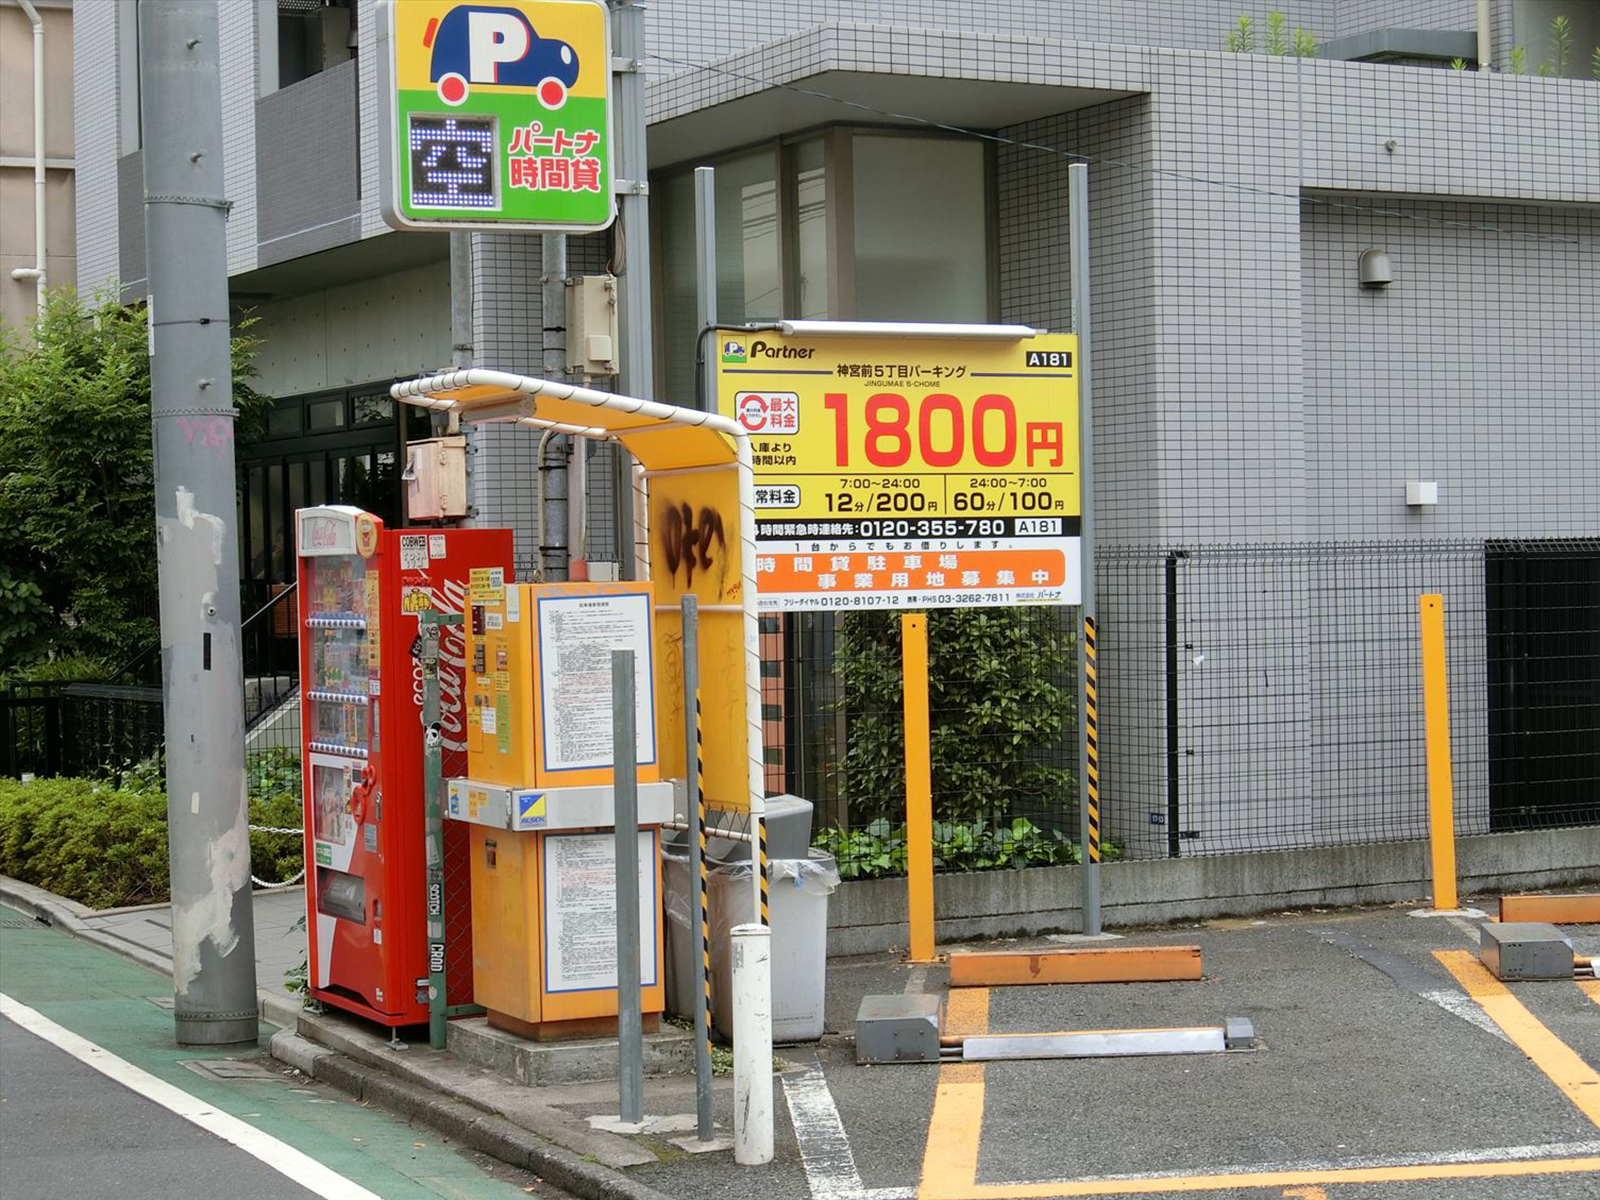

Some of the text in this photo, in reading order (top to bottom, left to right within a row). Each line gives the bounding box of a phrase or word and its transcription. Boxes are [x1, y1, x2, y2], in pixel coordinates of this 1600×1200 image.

[508, 121, 600, 156] パートナ
[411, 120, 494, 205] 空
[510, 157, 601, 192] 時間貸
[750, 340, 816, 359] Partner
[1028, 353, 1068, 366] A181
[864, 380, 941, 388] JINGUMAE 5-CHOME
[770, 398, 796, 412] 最大
[770, 413, 796, 428] 料金
[1018, 520, 1057, 533] A181
[402, 536, 426, 547] COBWEB
[817, 569, 1050, 589] 事業用地募集中
[429, 884, 440, 916] SCOTCH
